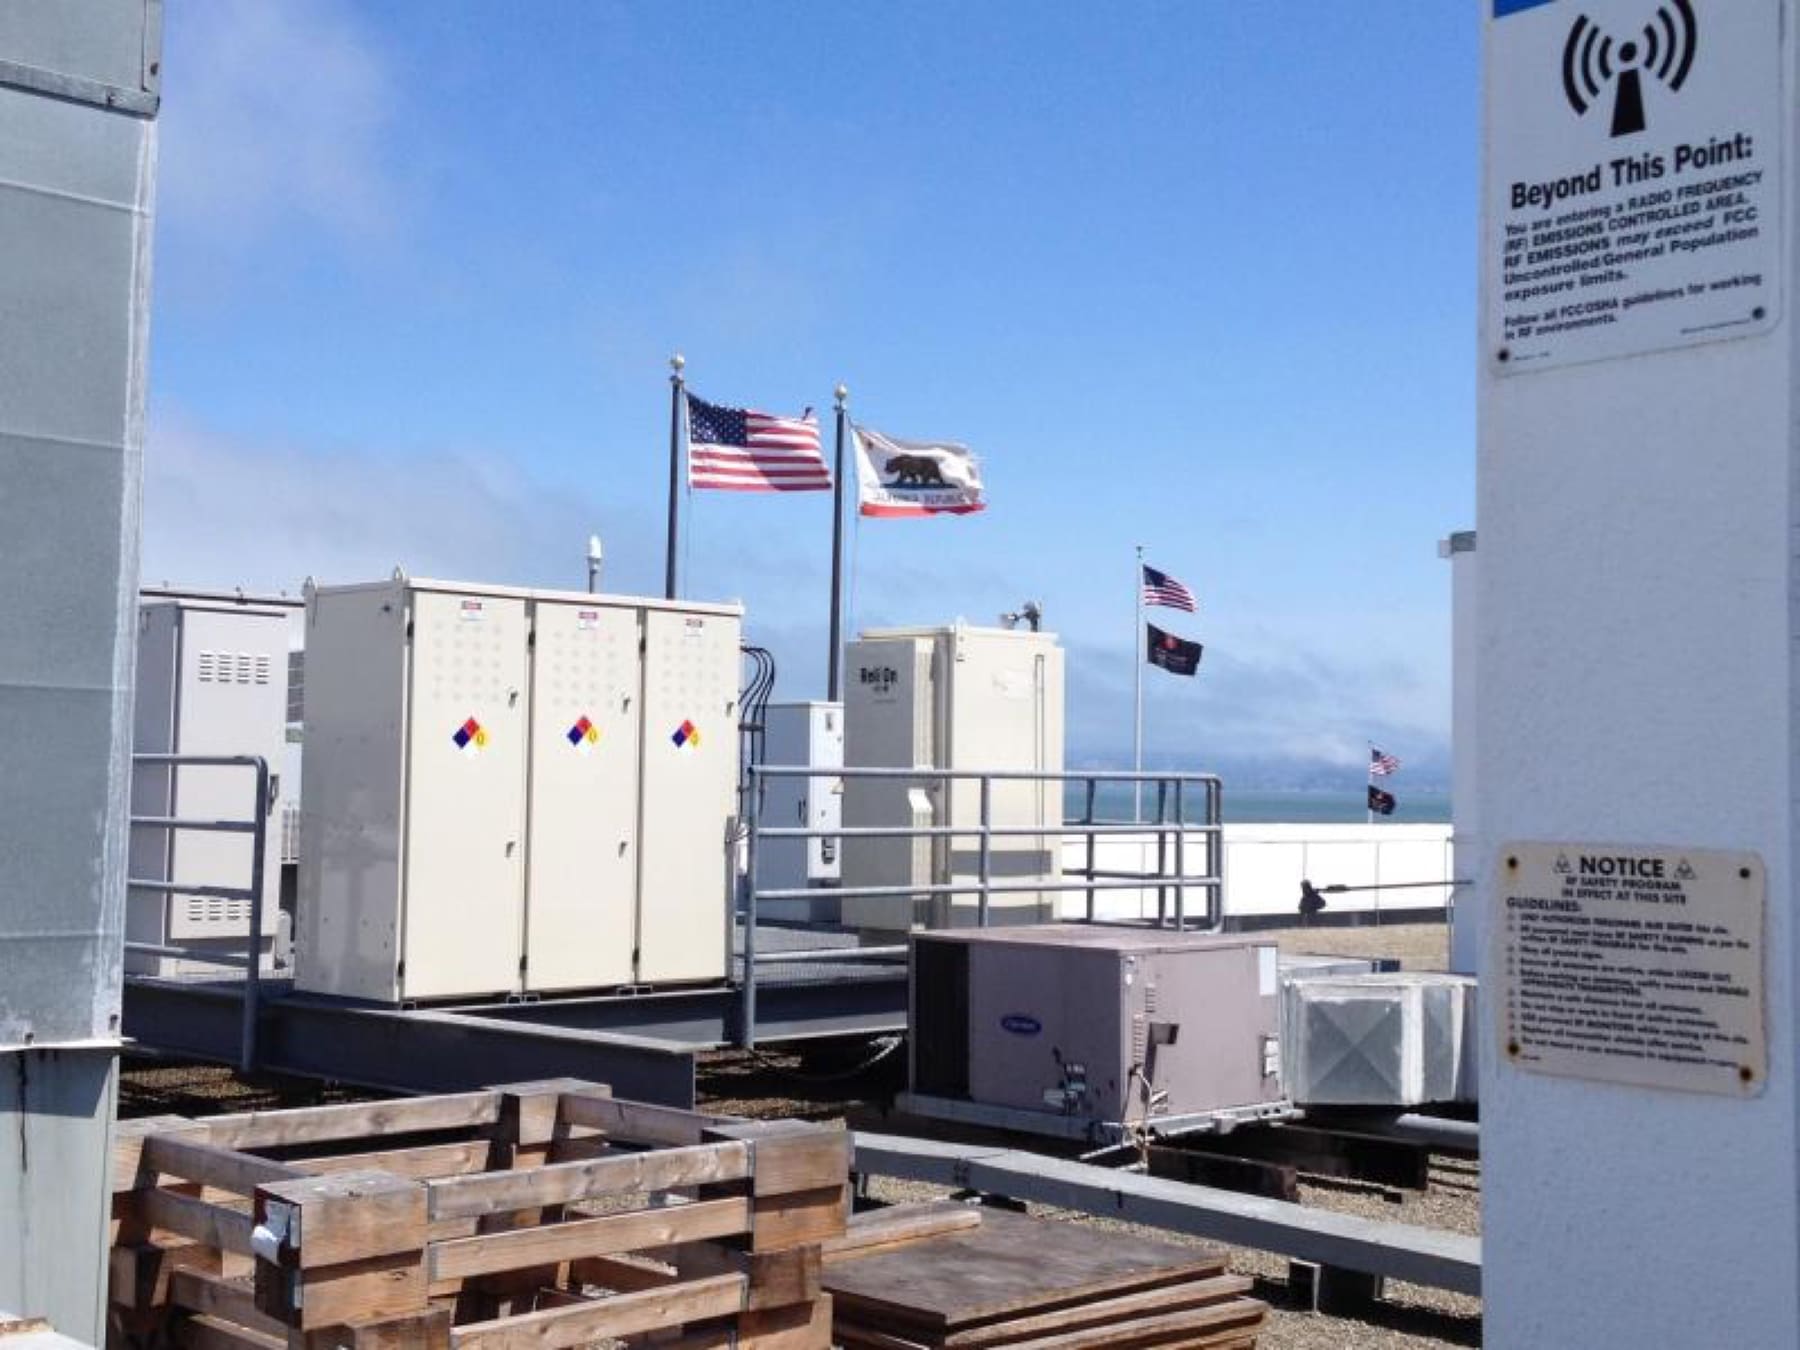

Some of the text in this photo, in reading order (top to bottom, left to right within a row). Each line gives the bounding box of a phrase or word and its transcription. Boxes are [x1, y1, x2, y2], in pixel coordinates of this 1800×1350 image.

[1510, 132, 1753, 210] Beyond This Point:
[1505, 224, 1528, 237] You
[1531, 219, 1552, 232] are
[1556, 206, 1612, 225] entering
[1628, 189, 1673, 211] RADIO
[1676, 170, 1763, 199] FREQUENCY
[1533, 221, 1604, 247] EMISSIONS
[1608, 201, 1700, 232] CONTROLLED
[1504, 206, 1758, 268] RF EMISSIONS may exceed FCC
[1670, 227, 1759, 253] Population
[1504, 279, 1575, 302] exposure
[1579, 856, 1665, 879] NOTICE
